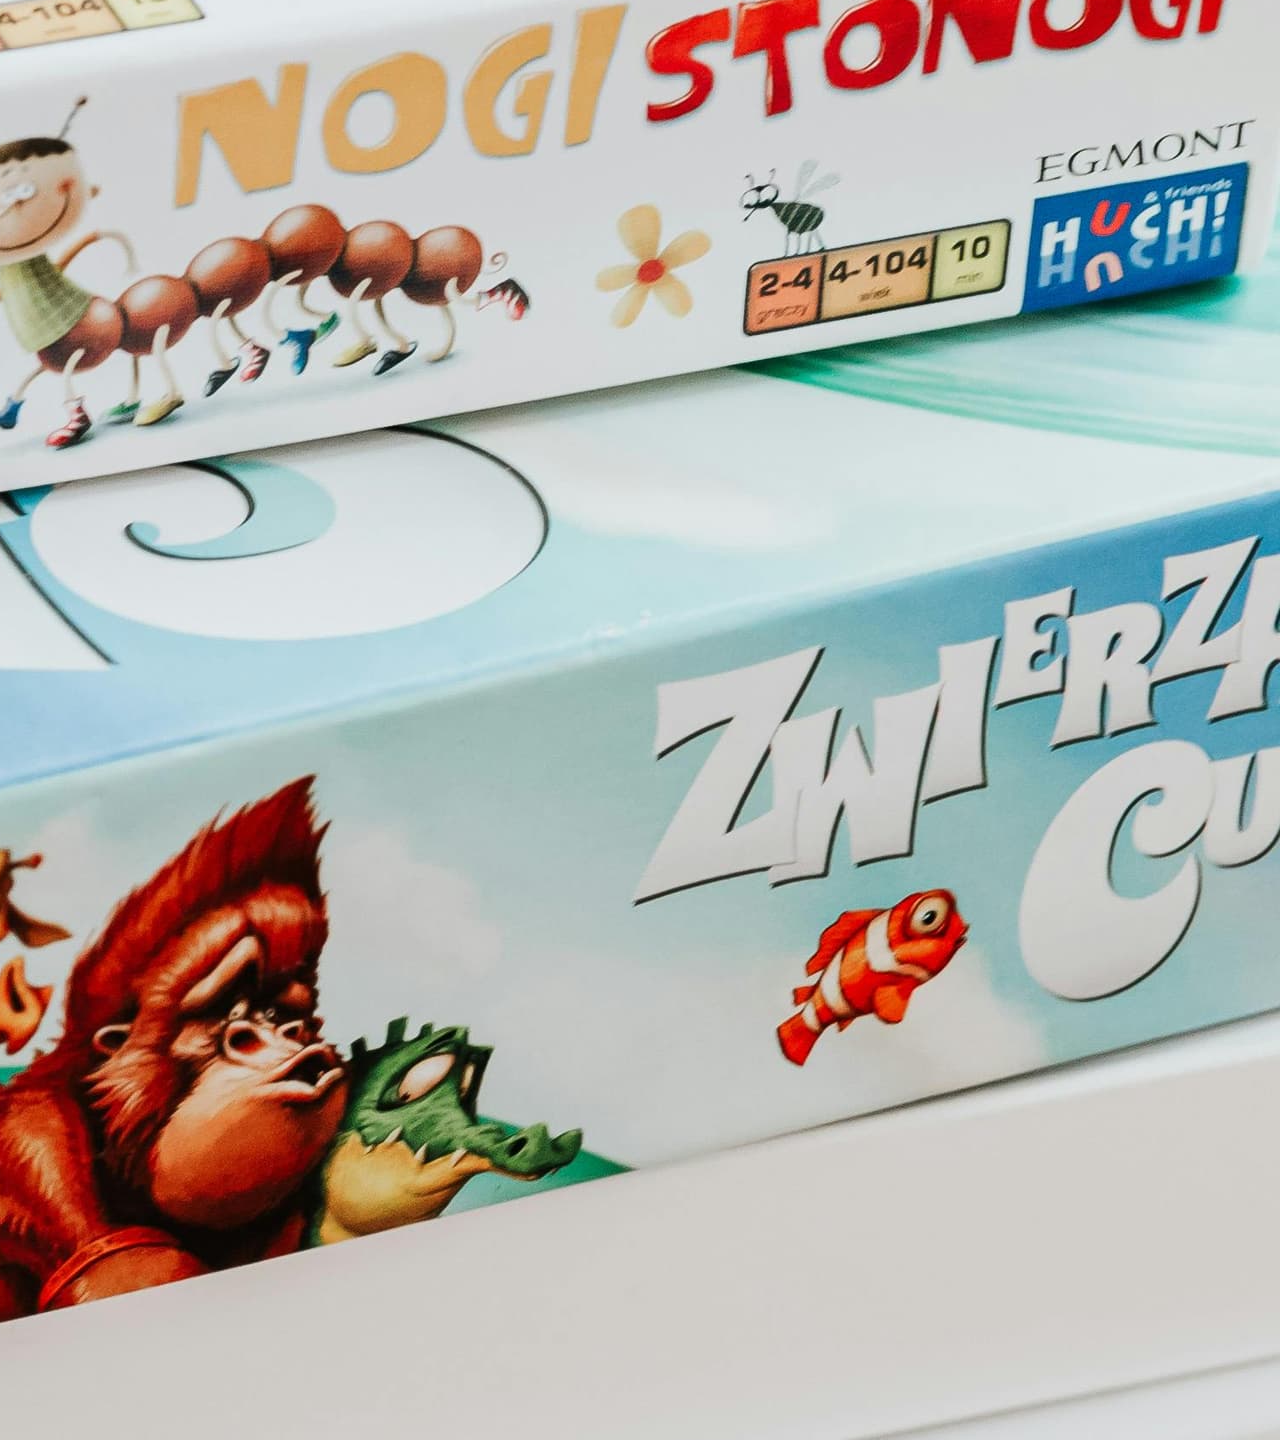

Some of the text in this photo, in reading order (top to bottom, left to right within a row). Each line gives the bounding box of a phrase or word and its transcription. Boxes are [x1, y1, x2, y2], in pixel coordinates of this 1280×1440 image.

[173, 3, 629, 210] NOGI
[1033, 118, 1257, 185] EGMONT
[1163, 177, 1233, 201] friends
[1039, 190, 1231, 258] HUCH!
[758, 234, 992, 298] 2-4 4-104 10
